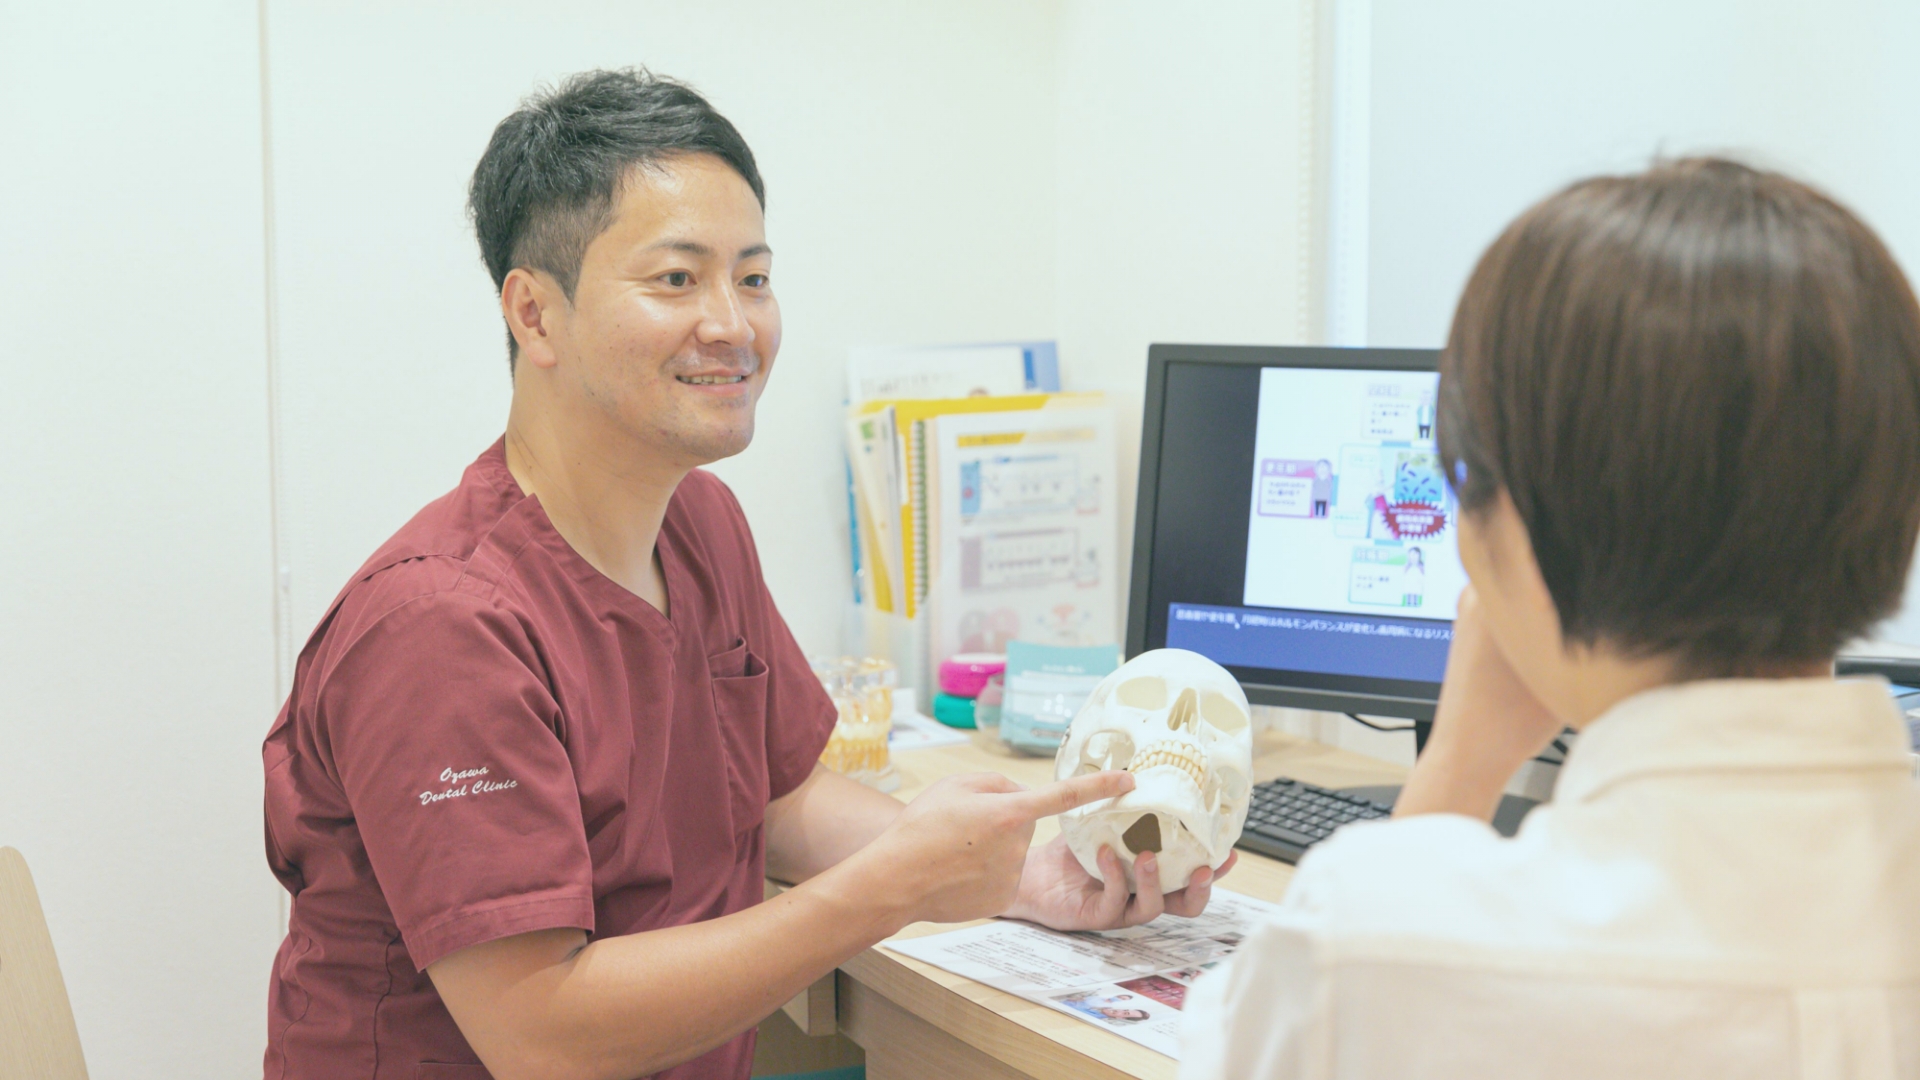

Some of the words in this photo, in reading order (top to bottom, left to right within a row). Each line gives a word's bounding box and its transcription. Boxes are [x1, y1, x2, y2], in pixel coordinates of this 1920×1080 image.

[440, 766, 489, 784] Ozawa
[419, 785, 467, 805] Dental
[472, 780, 518, 794] Clinic
